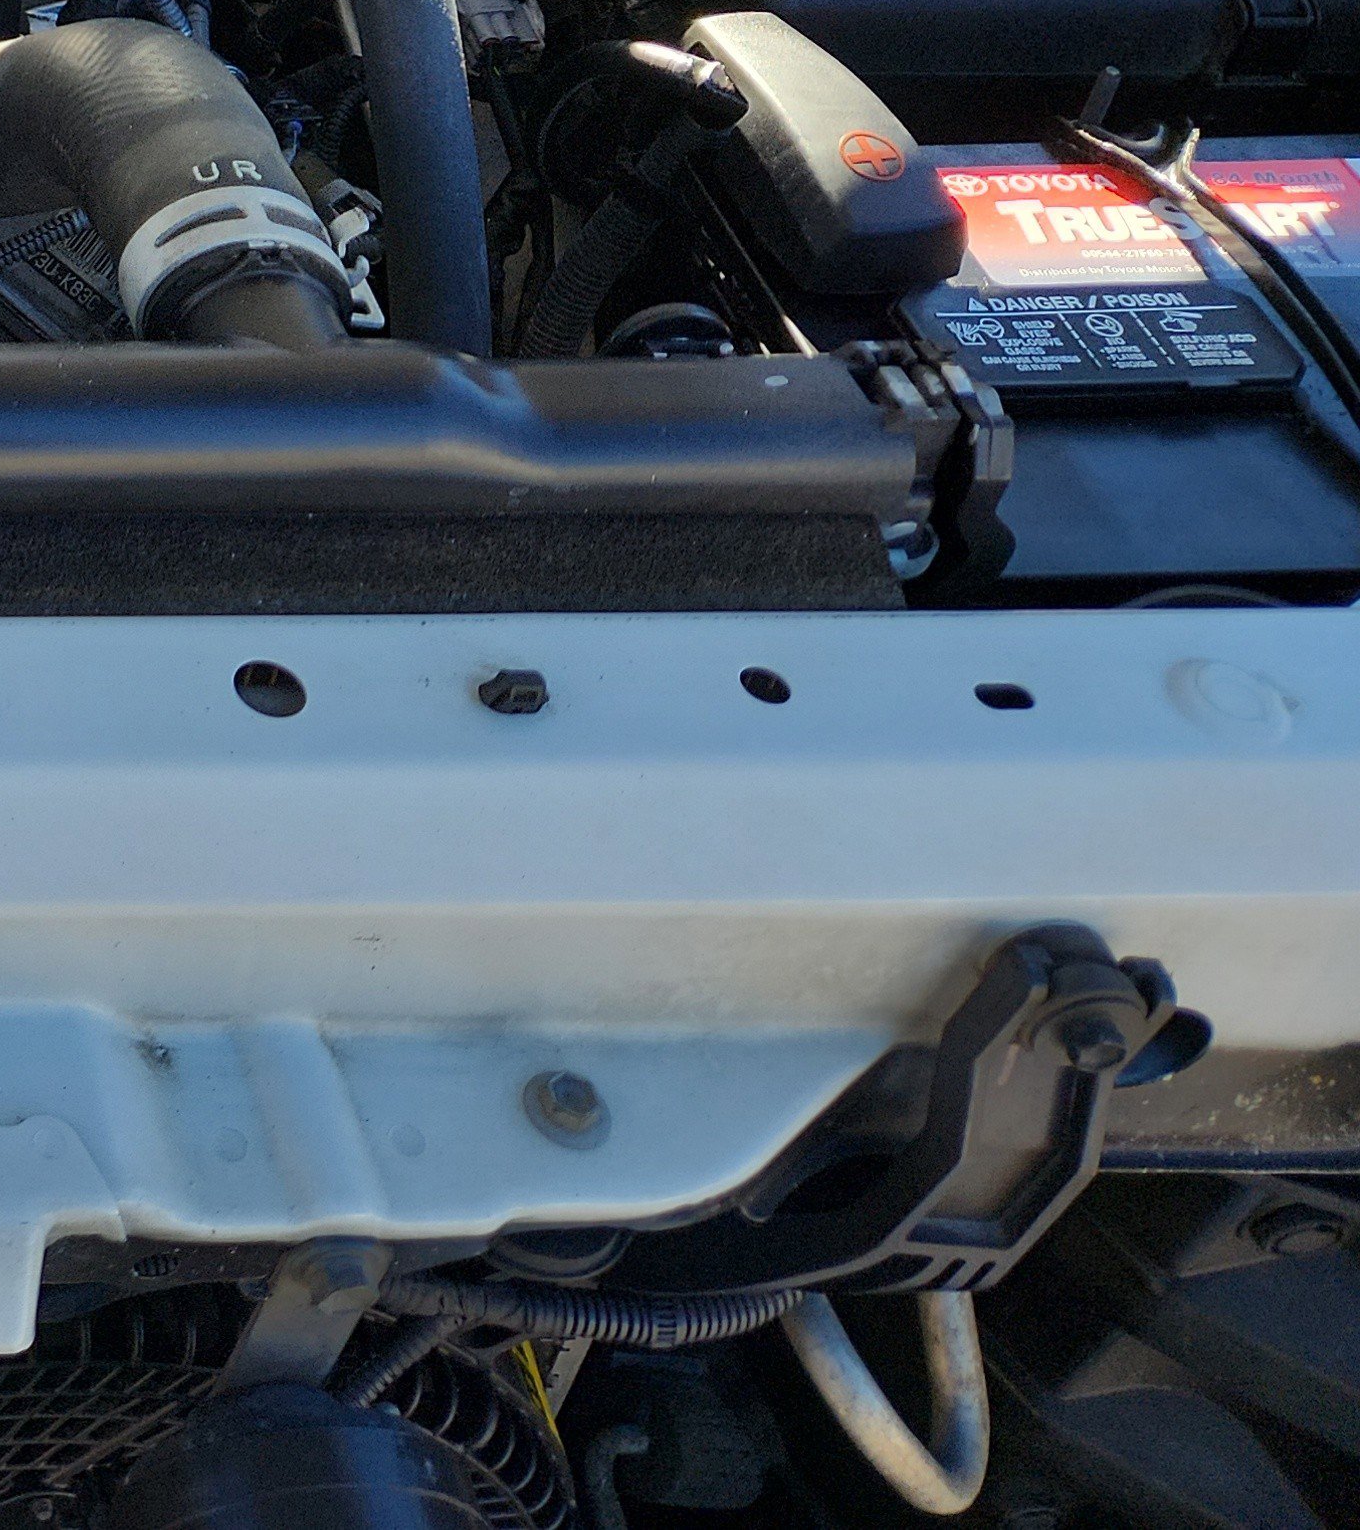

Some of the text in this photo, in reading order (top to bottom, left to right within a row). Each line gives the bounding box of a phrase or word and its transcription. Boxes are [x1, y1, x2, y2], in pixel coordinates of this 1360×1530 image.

[987, 173, 1118, 193] TOYOTA
[1018, 267, 1088, 278] Distributed
[1103, 264, 1144, 275] Toyota
[987, 295, 1084, 312] DANGER
[1102, 292, 1190, 308] POISON
